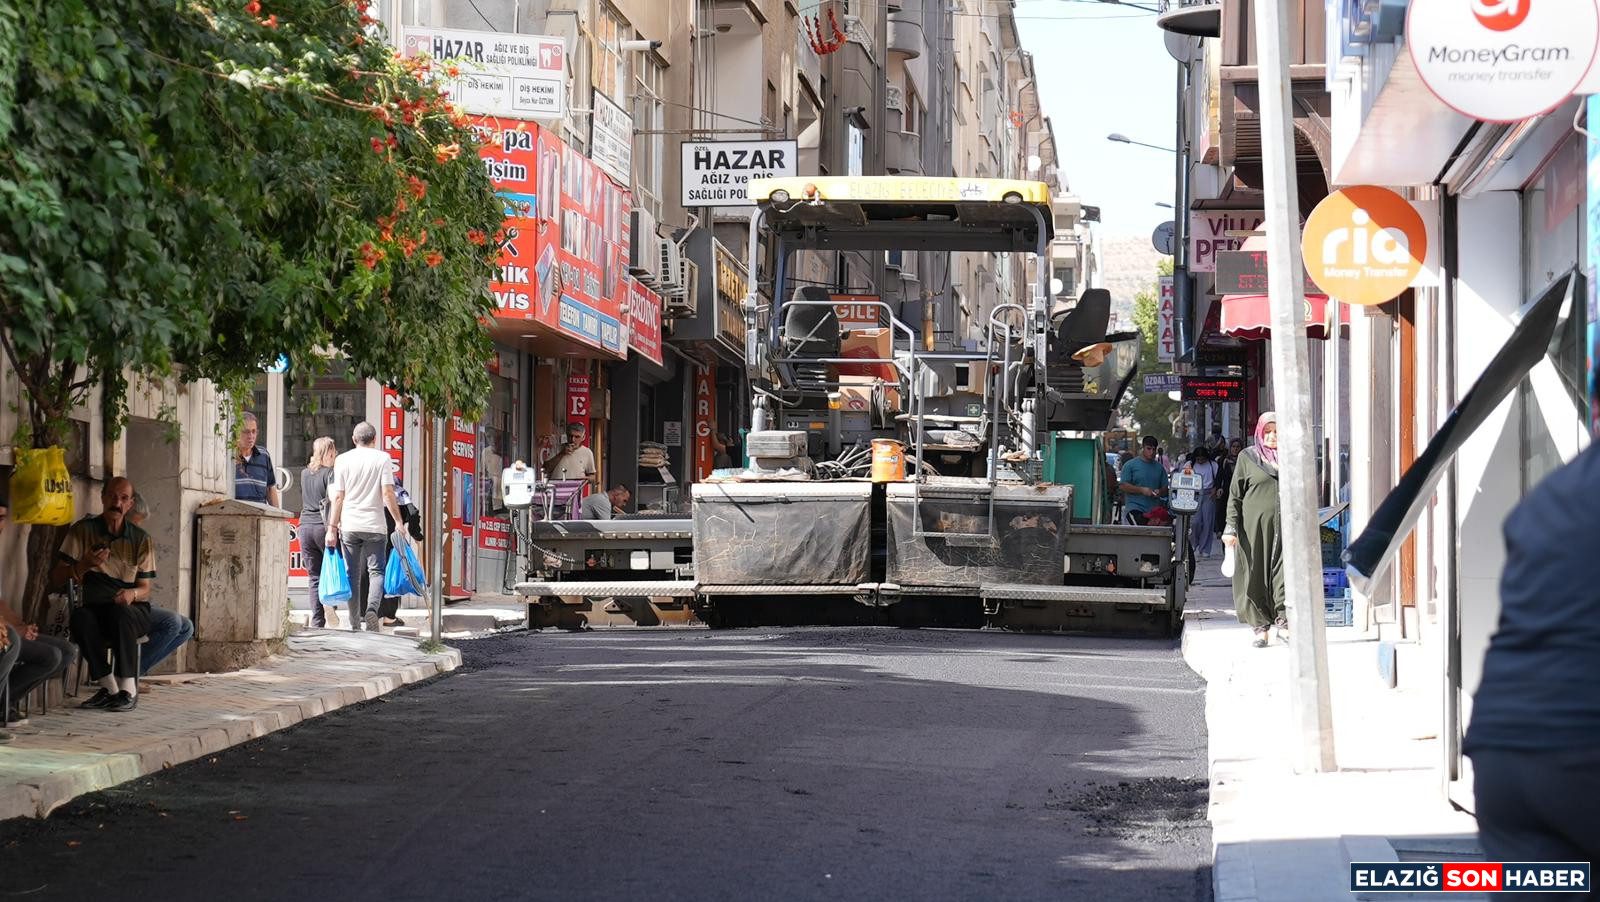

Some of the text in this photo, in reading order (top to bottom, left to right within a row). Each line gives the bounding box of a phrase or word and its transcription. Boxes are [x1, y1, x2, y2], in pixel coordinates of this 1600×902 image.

[433, 38, 484, 63] HAZAR
[494, 43, 529, 56] AĞIZ VE DİŞ
[1428, 44, 1569, 66] MoneyGram
[1448, 69, 1553, 83] money transfer
[480, 82, 504, 91] HEKİMİ
[532, 85, 555, 94] HEKİMİ
[694, 150, 786, 170] HAZAR
[701, 171, 730, 185] AĞIZ
[734, 175, 748, 184] ve
[688, 187, 748, 200] SAĞLIĞI POL
[1323, 208, 1410, 265] ria
[493, 262, 530, 284] NİK
[1323, 266, 1408, 279] Money Transfer
[494, 288, 530, 310] VİS
[833, 297, 875, 319] GİLE
[1161, 285, 1175, 353] HAYAT
[571, 396, 587, 415] E
[452, 439, 474, 459] SERVİS
